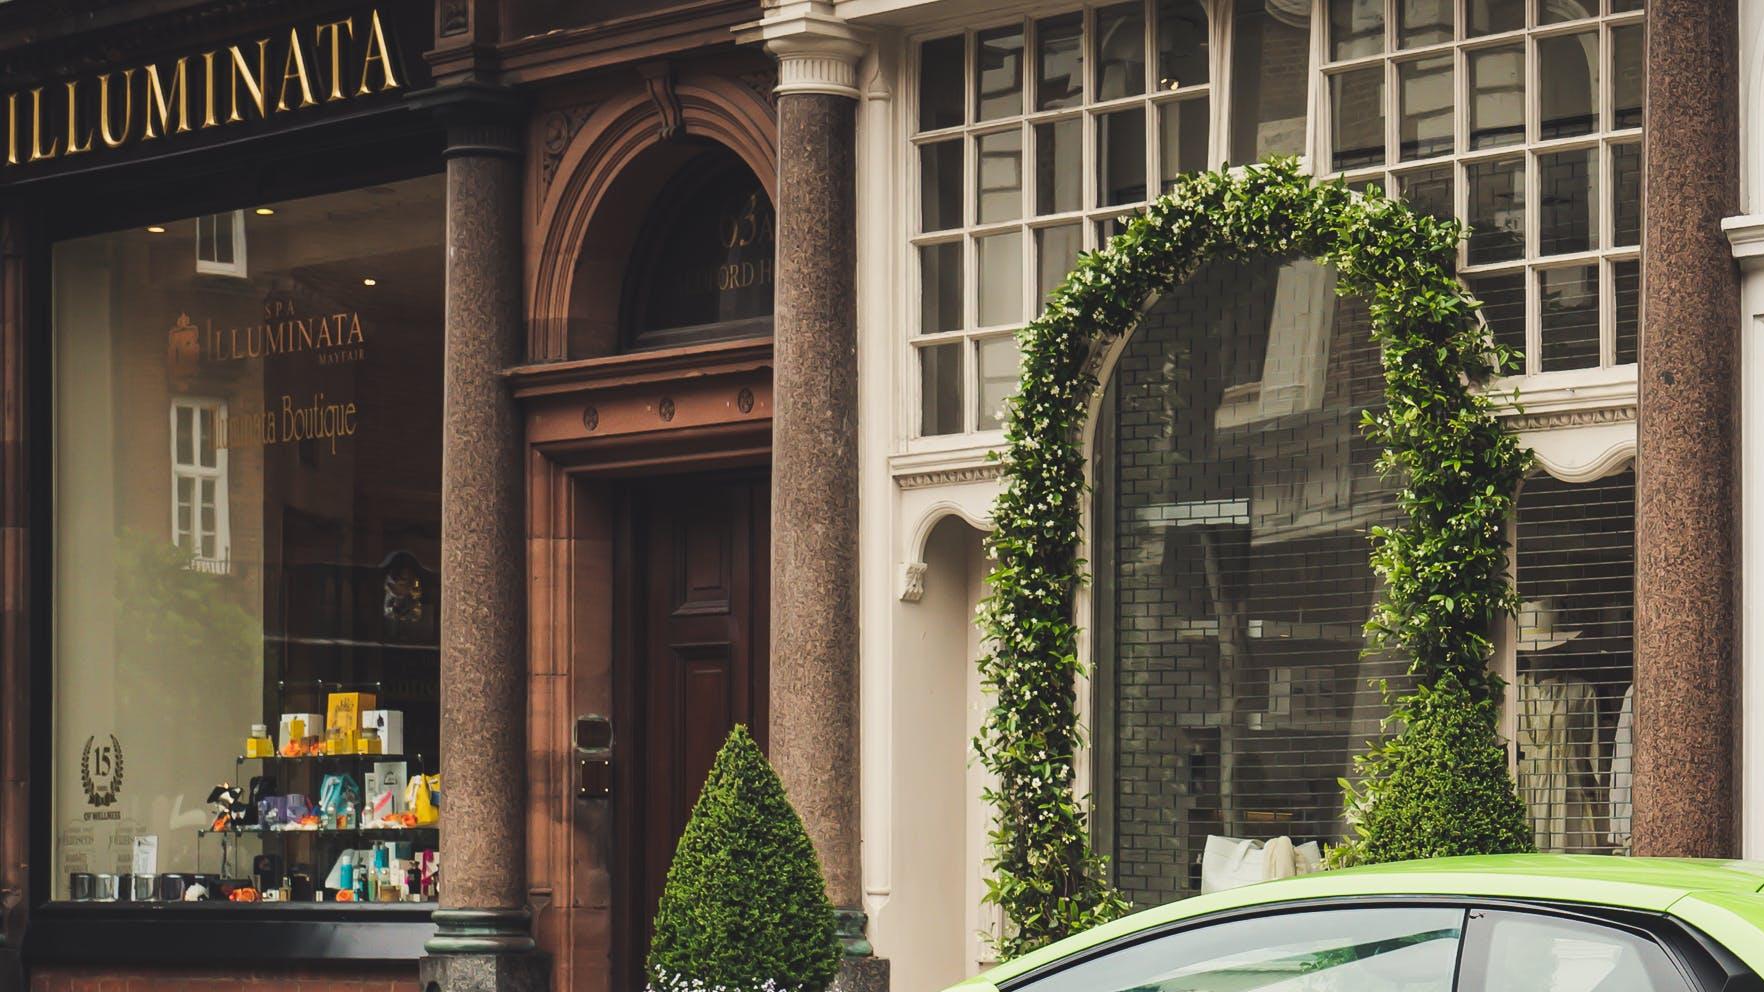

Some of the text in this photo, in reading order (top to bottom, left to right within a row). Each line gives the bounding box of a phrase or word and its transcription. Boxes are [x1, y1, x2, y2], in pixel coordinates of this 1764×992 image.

[6, 8, 401, 166] ILLUMINATA
[265, 300, 295, 317] SPA
[206, 311, 364, 360] ILLUMINATA
[319, 350, 365, 366] MAYFAIR
[281, 392, 359, 455] Boutique
[94, 745, 112, 776] 15
